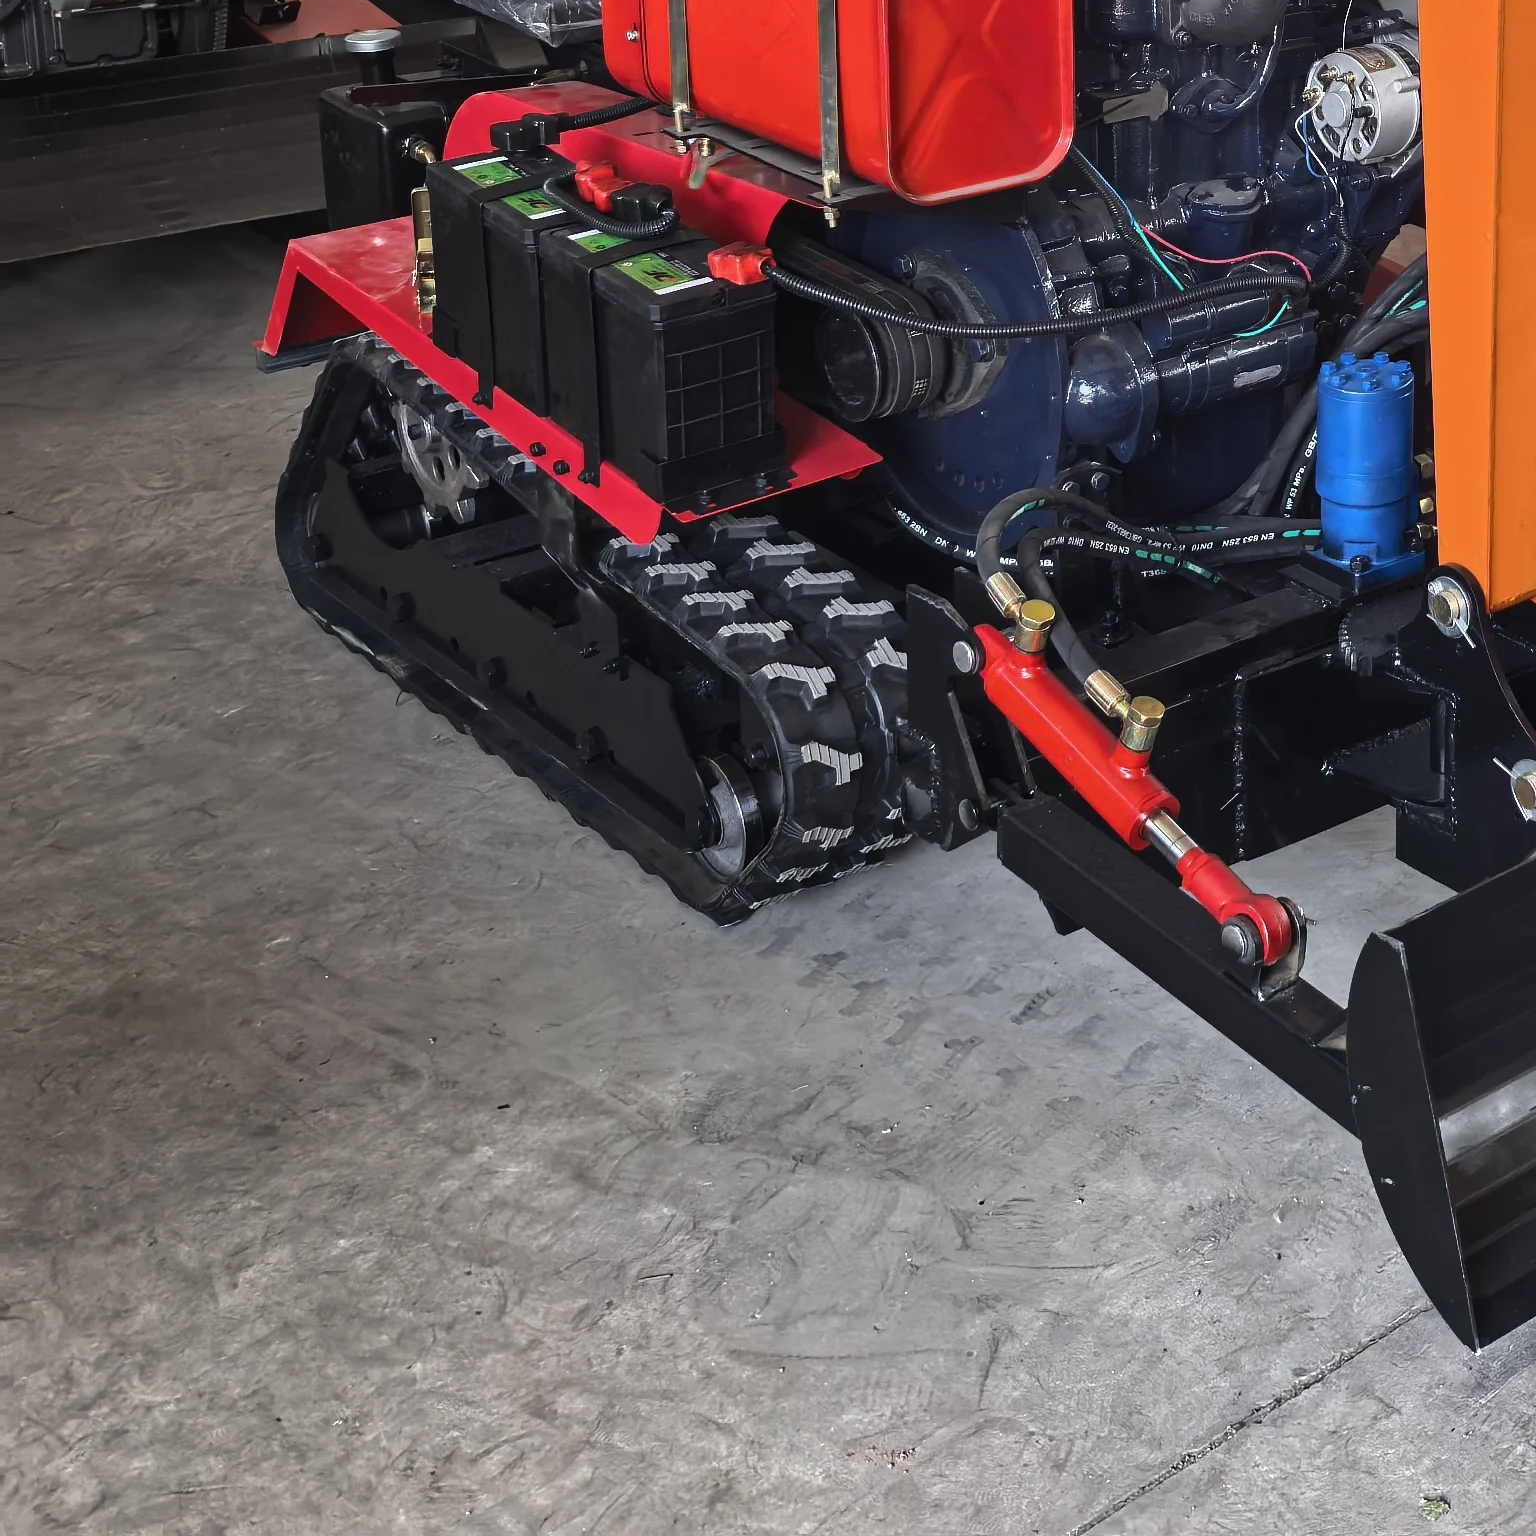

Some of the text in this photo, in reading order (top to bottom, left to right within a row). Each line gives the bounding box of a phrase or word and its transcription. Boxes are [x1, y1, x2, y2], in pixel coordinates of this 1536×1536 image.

[1285, 498, 1293, 510] WP
[1289, 486, 1298, 499] 53
[1243, 533, 1258, 544] 853
[1261, 532, 1275, 541] EN
[1089, 539, 1104, 550] 2SN
[1105, 543, 1118, 553] 853
[1191, 542, 1214, 552] DN10
[1222, 538, 1240, 548] 2SN
[1118, 545, 1130, 555] EN
